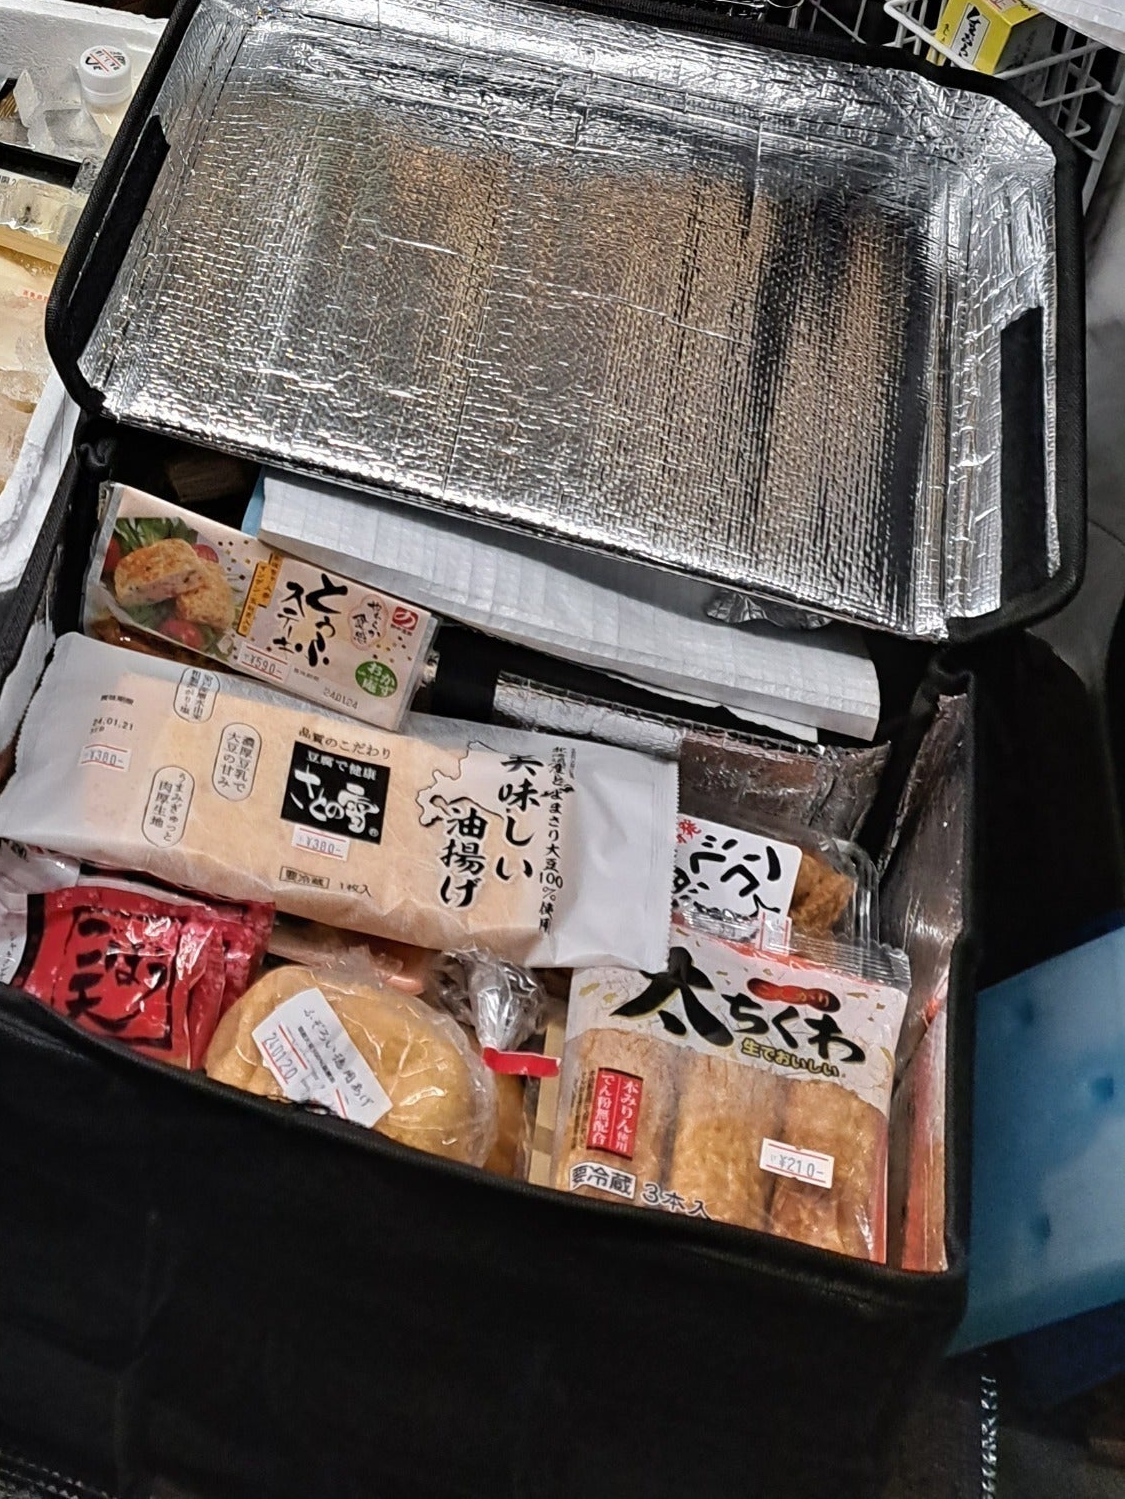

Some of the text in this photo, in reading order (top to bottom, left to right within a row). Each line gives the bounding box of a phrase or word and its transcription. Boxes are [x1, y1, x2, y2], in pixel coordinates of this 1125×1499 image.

[273, 581, 306, 660] ステーキ
[217, 732, 242, 788] 大豆の甘み
[233, 736, 256, 793] 濃厚豆乳で
[299, 726, 391, 760] 品質のこだわり
[307, 750, 377, 781] 豆腐で健康
[150, 781, 173, 828] 肉厚生地
[290, 764, 380, 834] さとの雪
[285, 869, 325, 887] 要冷蔵
[440, 807, 488, 908] 油揚げ
[572, 1165, 634, 1194] 要冷蔵
[640, 1183, 712, 1220] 3本入
